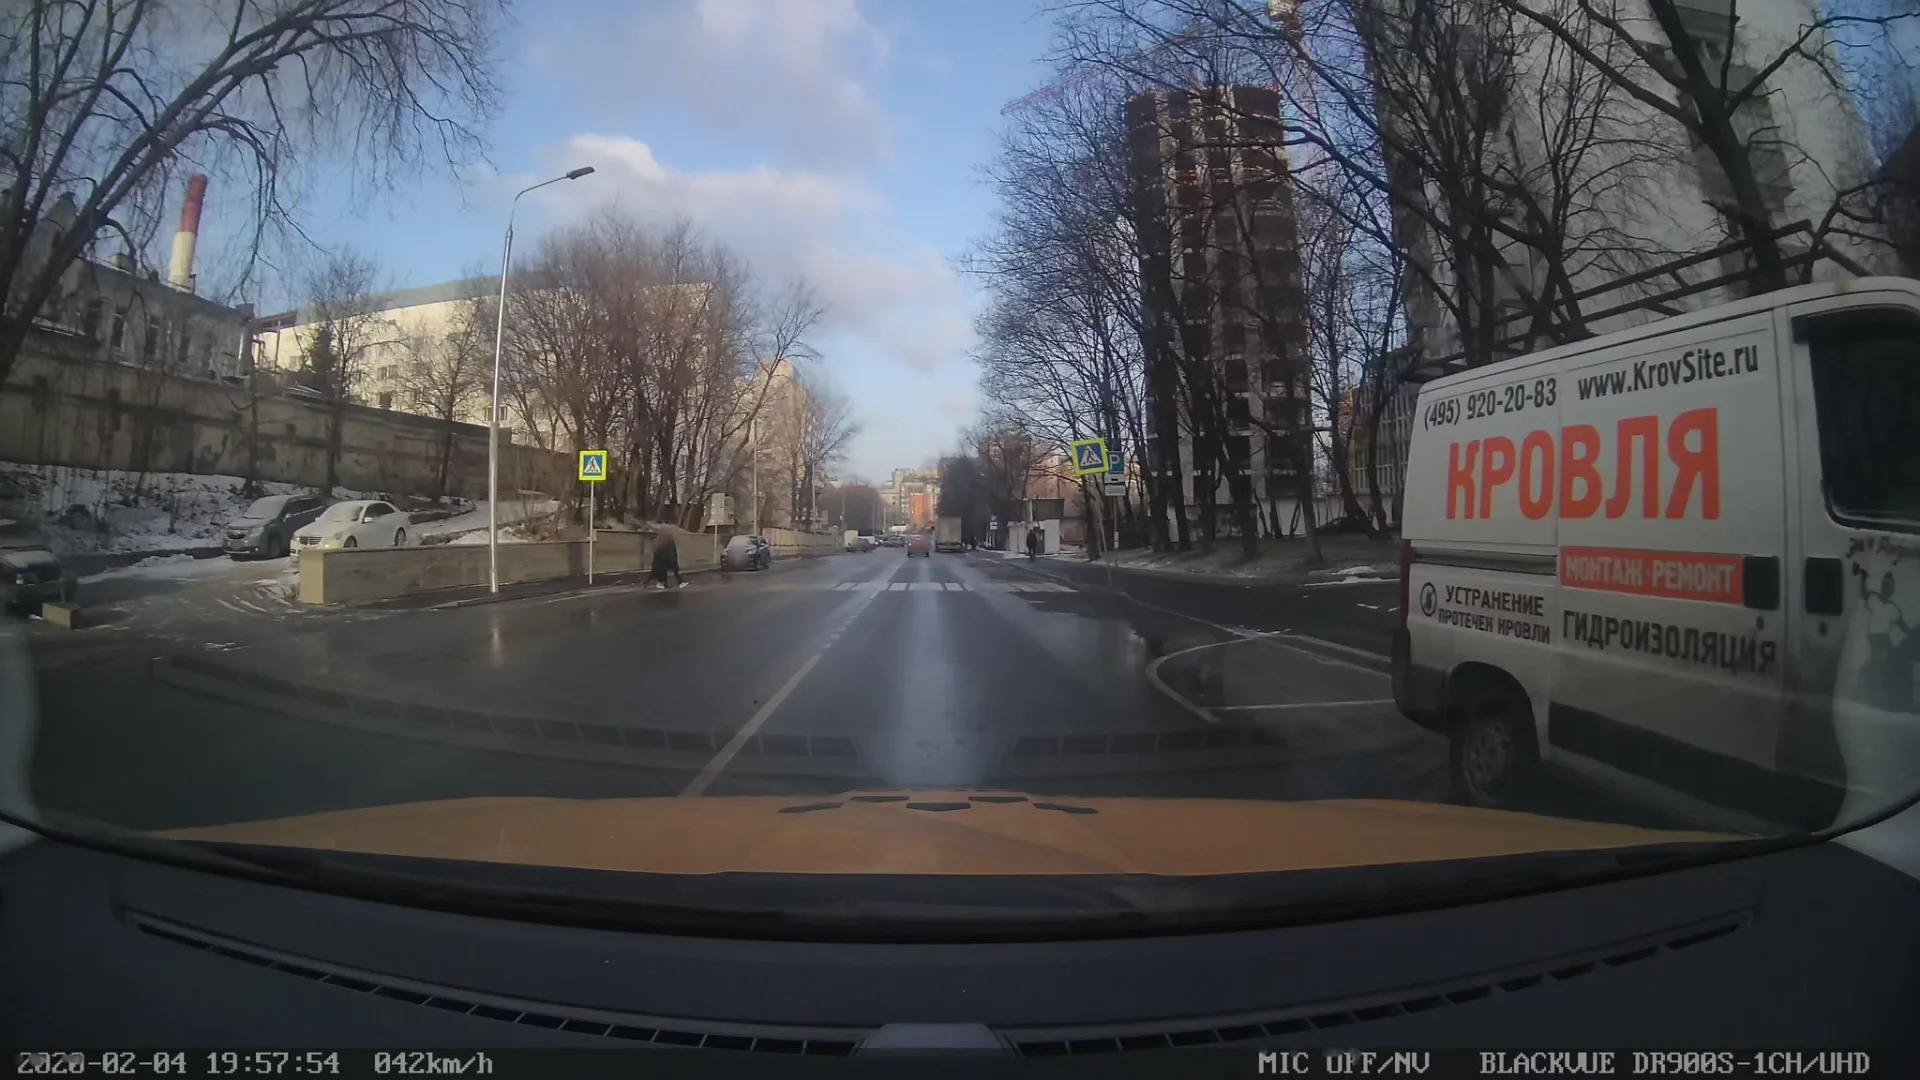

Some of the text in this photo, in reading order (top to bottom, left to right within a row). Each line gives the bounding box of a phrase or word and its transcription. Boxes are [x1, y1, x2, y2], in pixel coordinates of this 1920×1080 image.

[1578, 345, 1758, 400] www.KrovSite.ru
[1424, 378, 1557, 431] (495) 920-20-83
[1446, 408, 1720, 520] КРОВЛЯ
[1439, 608, 1550, 645] ПРОТЕЧЕК КРОВЛИ
[1445, 585, 1544, 617] УСТРАНЕНИЕ
[1563, 610, 1777, 675] ГИДРОИЗОЛЯЦИЯ
